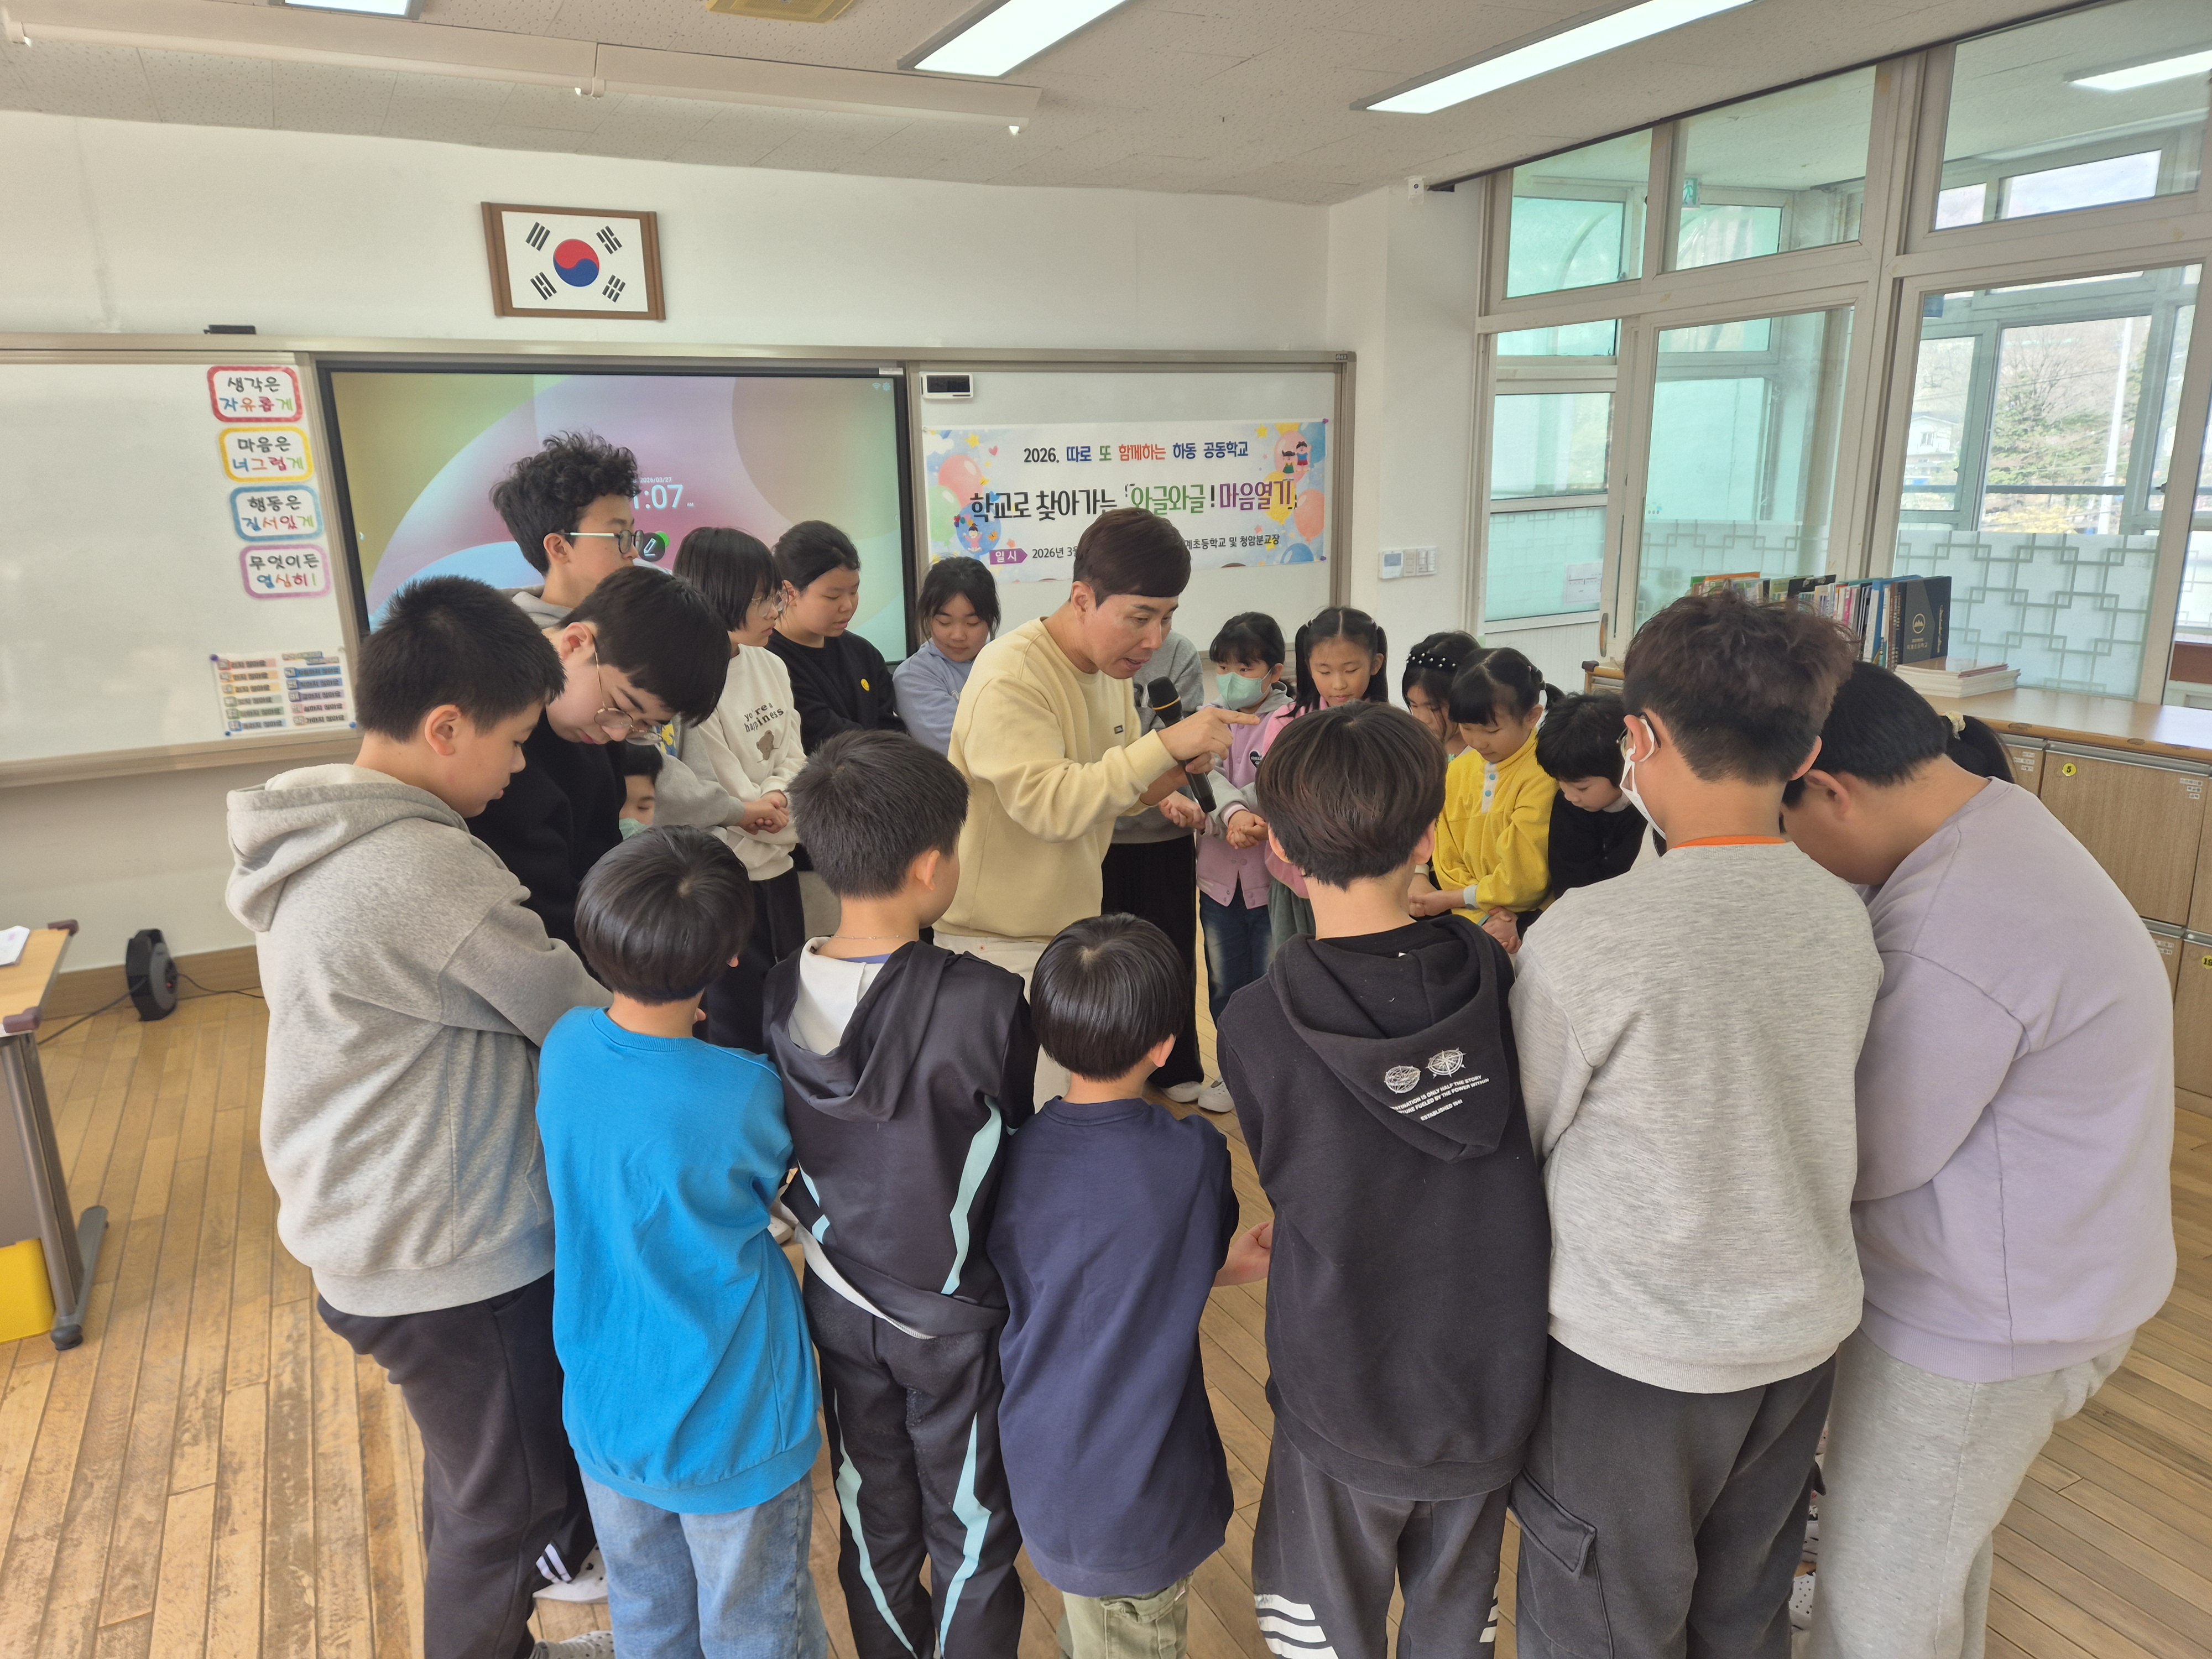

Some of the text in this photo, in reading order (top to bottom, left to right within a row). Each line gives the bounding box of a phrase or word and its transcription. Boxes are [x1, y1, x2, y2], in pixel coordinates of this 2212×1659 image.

[227, 376, 281, 393] 생각은
[220, 396, 294, 413] 자유롭게
[237, 436, 291, 453] 마음은
[1023, 440, 1249, 463] 2026. 따로 또 함께하는 하동 공동학교
[232, 456, 304, 472] 너그럽게
[247, 494, 302, 513] 행동은
[969, 491, 1032, 523] 학교로
[1035, 488, 1118, 521] 찾아가는
[241, 515, 315, 531] 질서있게
[1032, 546, 1064, 559] 2026년
[1229, 536, 1238, 548] 및
[1239, 534, 1280, 547] 청암분교장
[249, 553, 320, 571] 무엇이든
[256, 572, 317, 589] 열심히!
[1415, 1098, 1434, 1110] FUELED
[1451, 1084, 1471, 1094] POWER
[1470, 1078, 1490, 1088] WITHIN
[1427, 1088, 1440, 1098] ONLY
[1440, 1083, 1453, 1092] HALF
[1464, 1074, 1481, 1084] STORY
[1420, 1099, 1463, 1121] ESTABLISHED 1941
